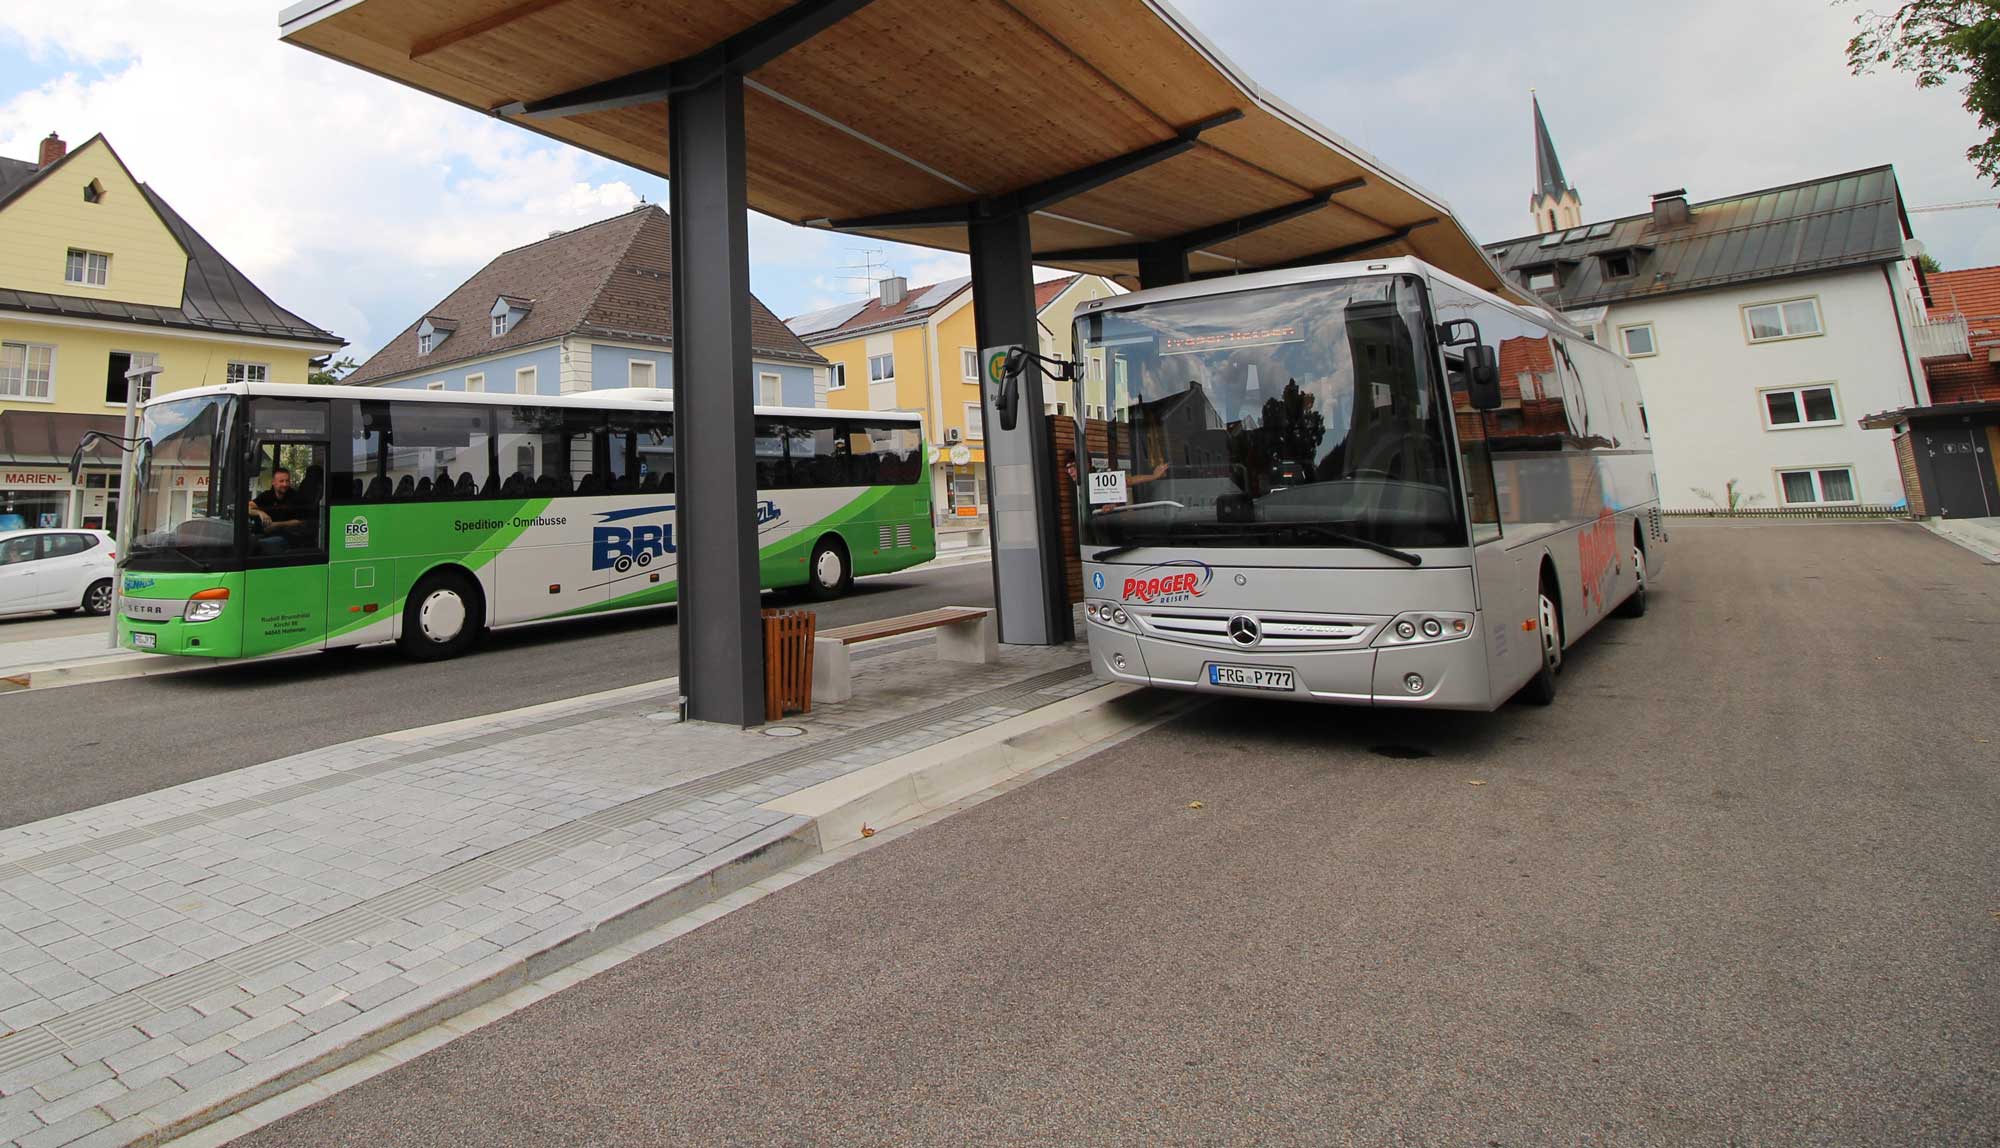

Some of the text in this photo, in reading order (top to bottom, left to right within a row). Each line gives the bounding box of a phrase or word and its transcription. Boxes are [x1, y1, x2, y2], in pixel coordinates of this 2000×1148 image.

[5, 473, 63, 484] MARIEN-
[1095, 474, 1117, 487] 100
[346, 524, 368, 534] FRG
[454, 520, 504, 533] Spedition
[512, 516, 567, 528] Omnibusse
[1122, 573, 1201, 603] PRAGER
[1160, 594, 1189, 604] REISEN
[128, 604, 162, 614] SETRA
[1217, 668, 1291, 687] FRG P 777
